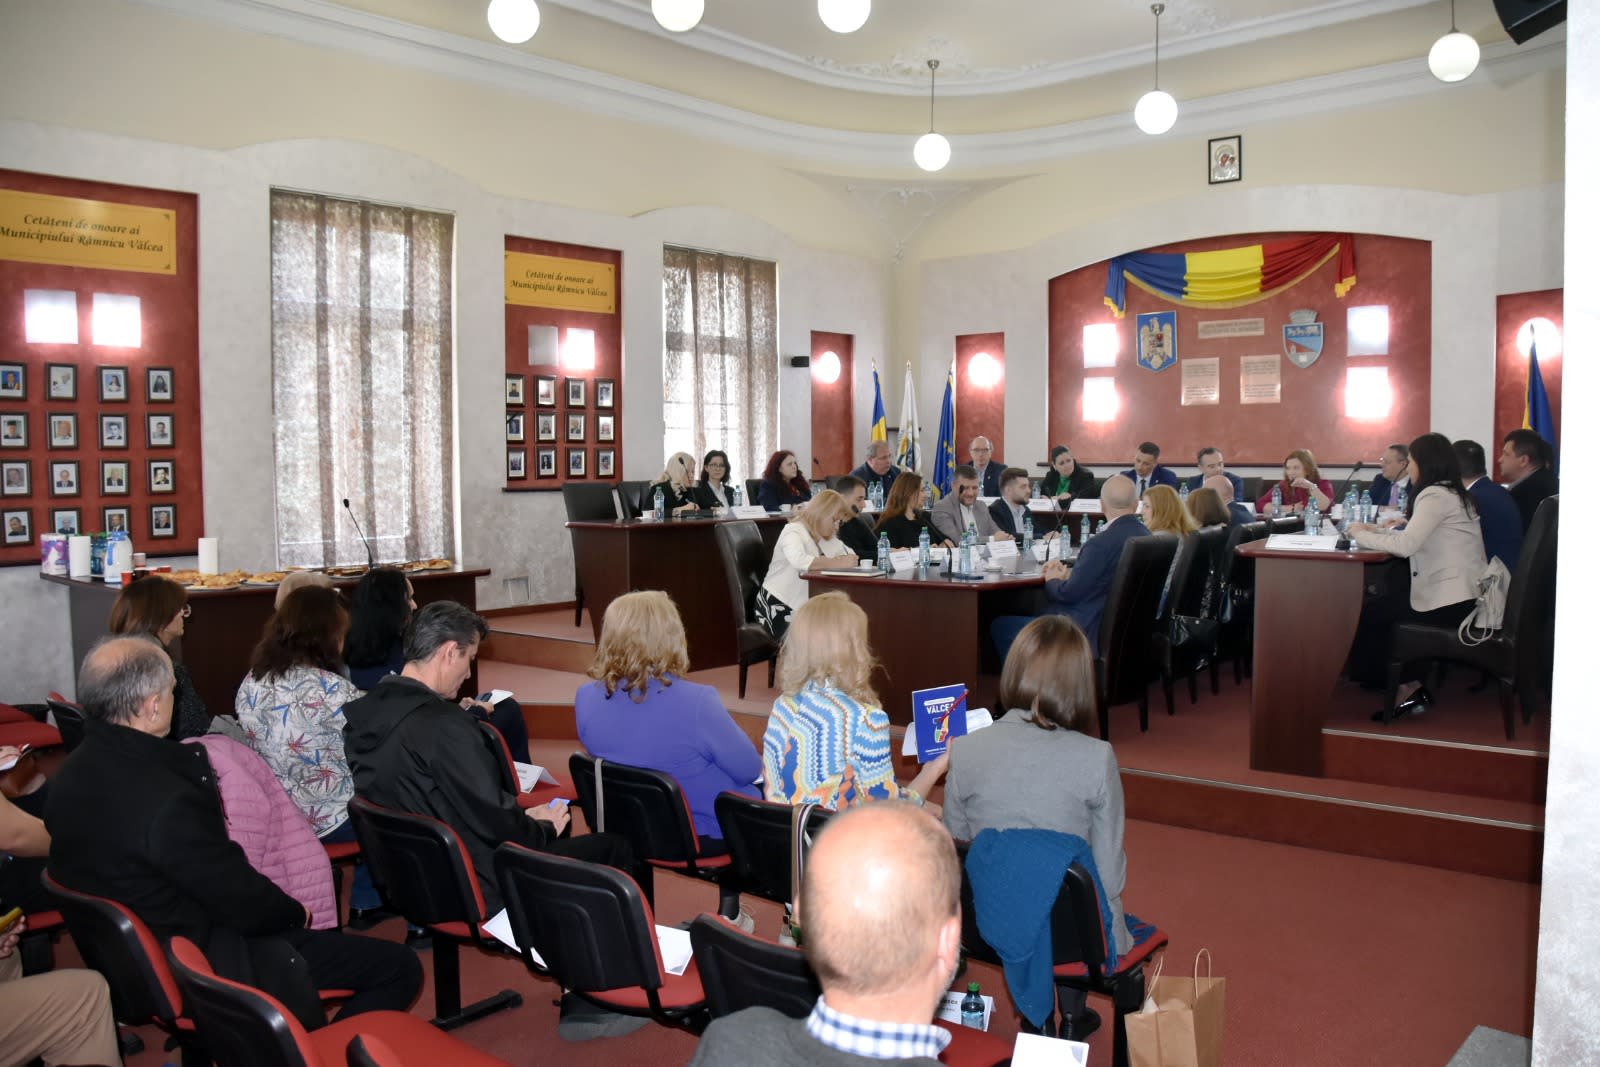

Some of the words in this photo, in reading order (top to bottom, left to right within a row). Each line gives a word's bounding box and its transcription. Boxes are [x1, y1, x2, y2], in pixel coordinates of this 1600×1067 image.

[75, 218, 88, 229] de
[91, 222, 127, 234] onoare
[129, 223, 140, 235] ai
[0, 226, 74, 243] Municipiului
[77, 235, 125, 249] Râmnicu
